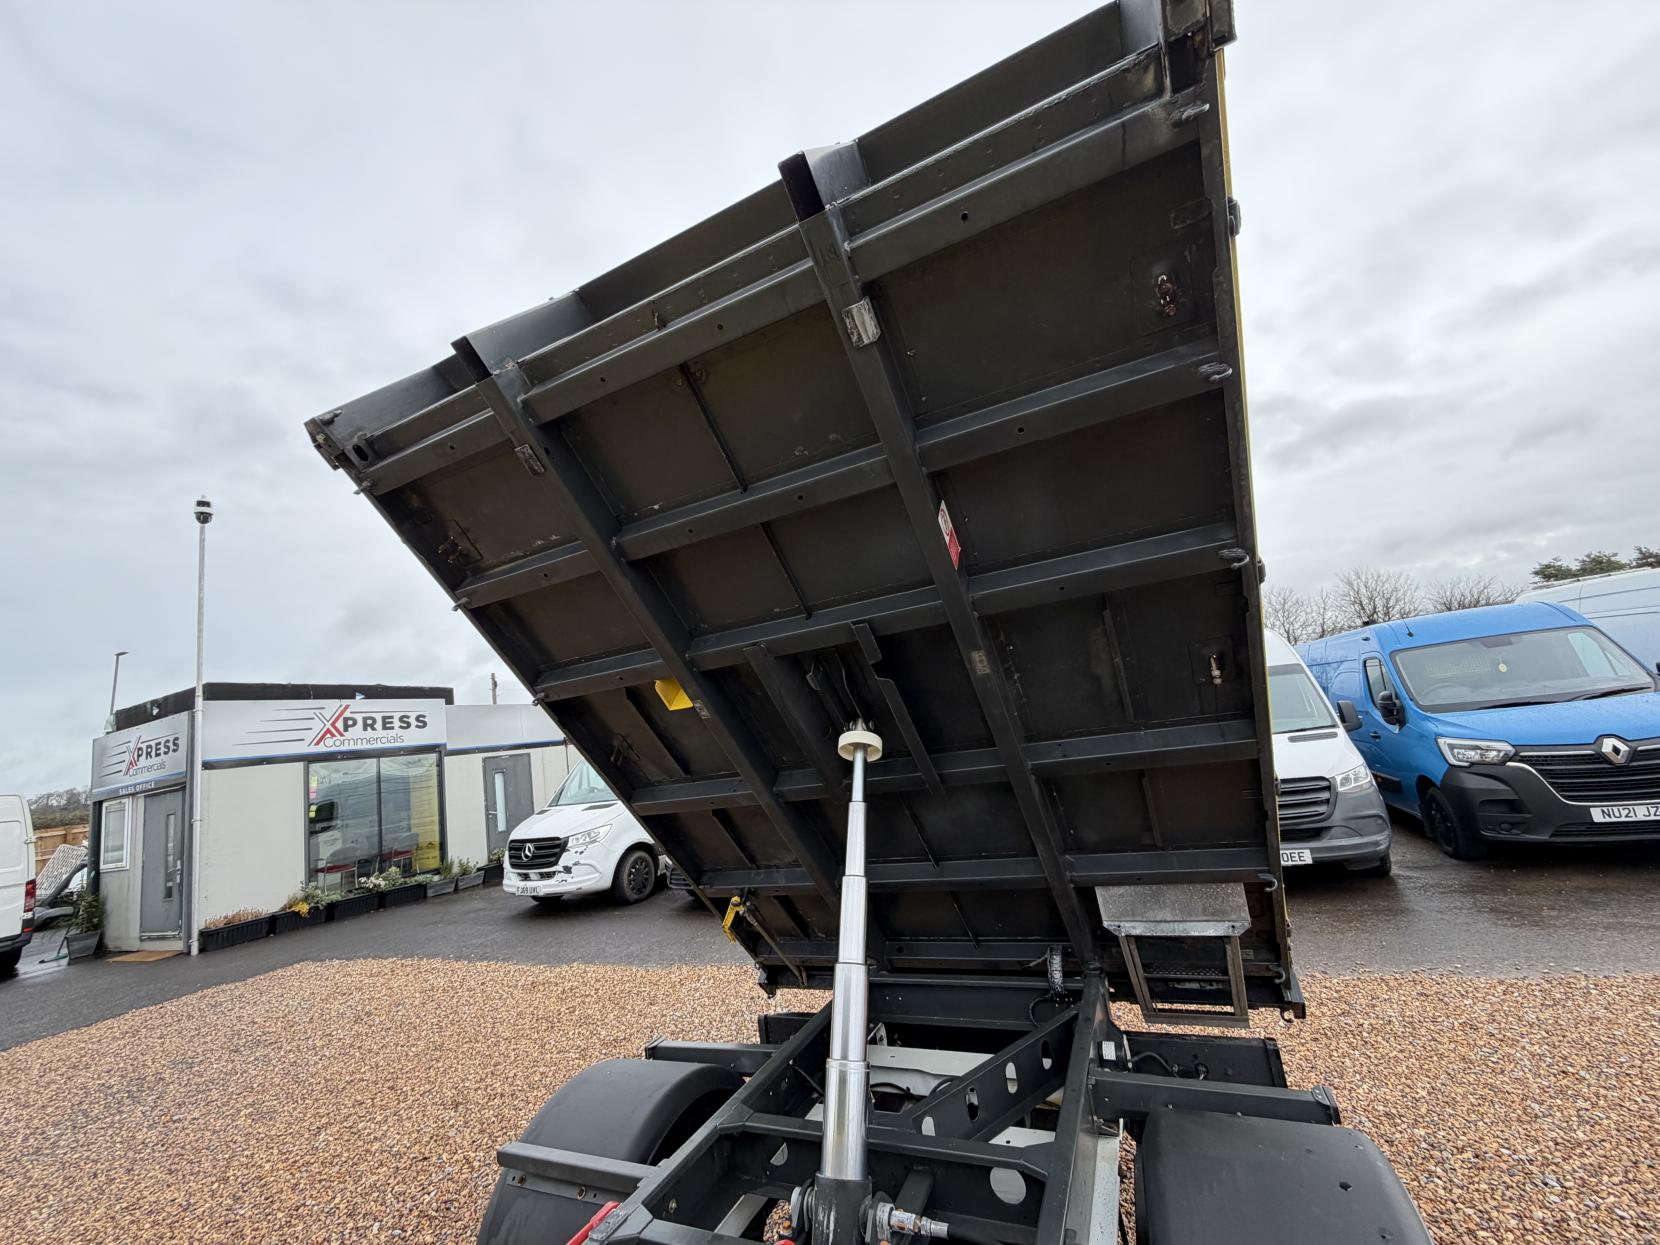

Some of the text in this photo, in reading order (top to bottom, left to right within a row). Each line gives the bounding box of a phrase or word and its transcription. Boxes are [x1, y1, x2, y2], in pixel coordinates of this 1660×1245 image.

[308, 704, 428, 746] XPRESS
[323, 733, 405, 748] Commercials
[123, 735, 180, 776] XPRESS
[128, 759, 167, 777] Commercials
[119, 782, 155, 795] SALES OFFICE
[1600, 806, 1638, 819] NU21
